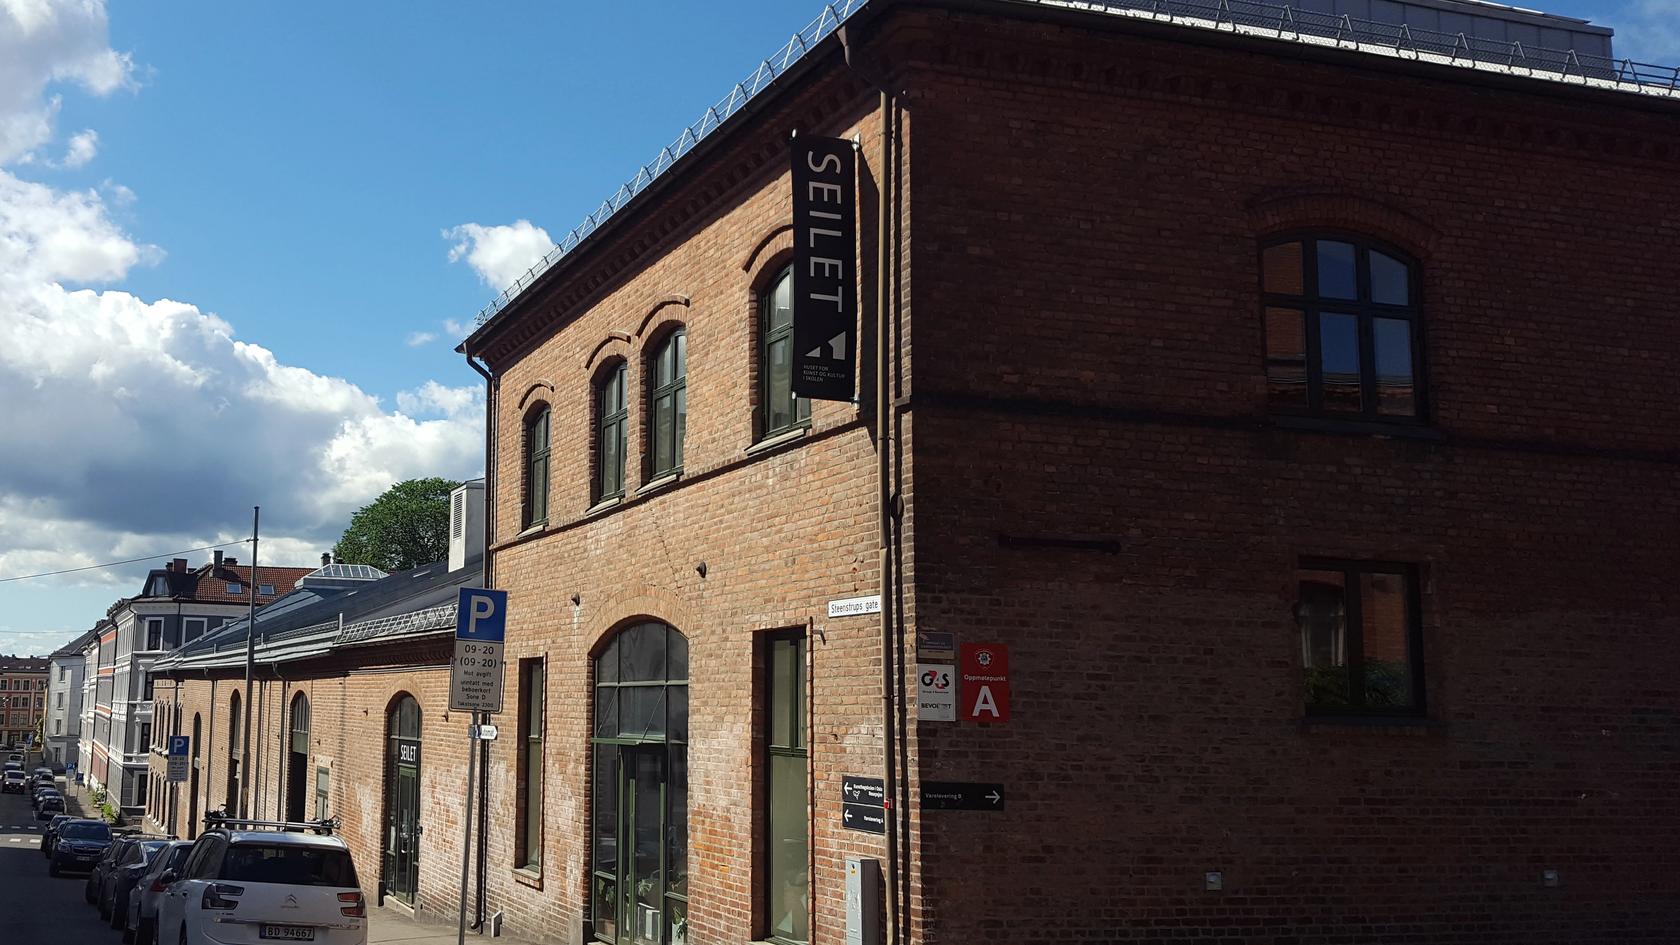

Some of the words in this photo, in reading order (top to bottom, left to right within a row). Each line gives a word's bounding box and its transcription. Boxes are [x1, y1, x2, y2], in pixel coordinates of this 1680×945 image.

[807, 150, 843, 313] SEILET
[468, 594, 495, 633] P
[831, 602, 863, 614] Steenstrups
[865, 600, 878, 612] gate
[920, 670, 950, 690] G4S
[972, 686, 1000, 718] A
[174, 738, 184, 753] P
[400, 744, 416, 762] SEILET
[268, 928, 280, 936] BD
[284, 928, 312, 938] 94667
